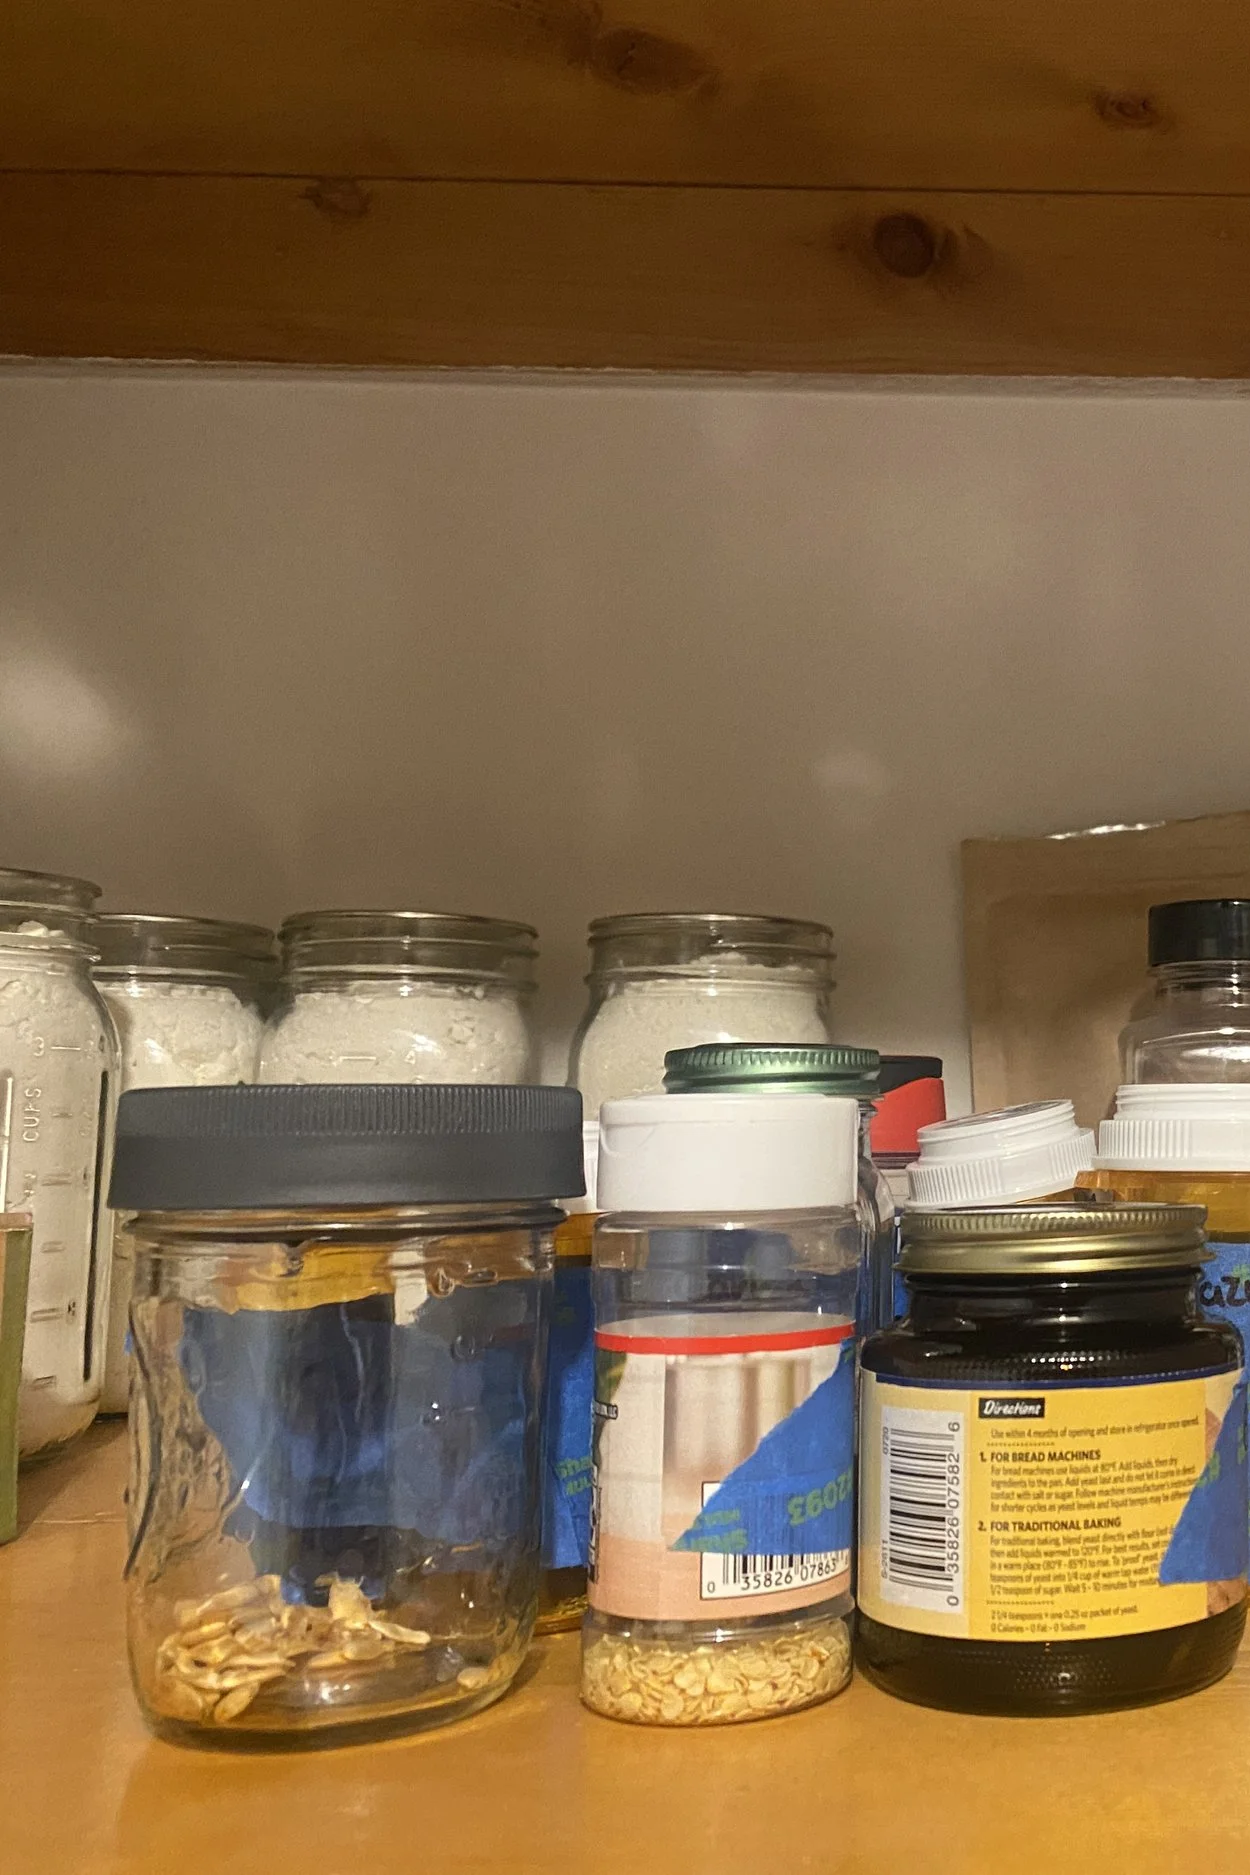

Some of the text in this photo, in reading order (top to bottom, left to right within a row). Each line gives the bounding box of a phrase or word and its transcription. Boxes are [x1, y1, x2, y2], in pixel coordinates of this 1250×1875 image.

[23, 1086, 42, 1143] CUPS
[983, 1399, 1042, 1416] Directions
[948, 1421, 960, 1432] 6
[980, 1449, 1101, 1463] 1. FOR BREAD MACHINES
[947, 1453, 960, 1509] 07582
[978, 1517, 1121, 1532] 2. FOR TRADITIONAL BAKING
[947, 1517, 960, 1574] 35826
[707, 1558, 837, 1593] 0 35826 07863
[947, 1596, 959, 1607] 0
